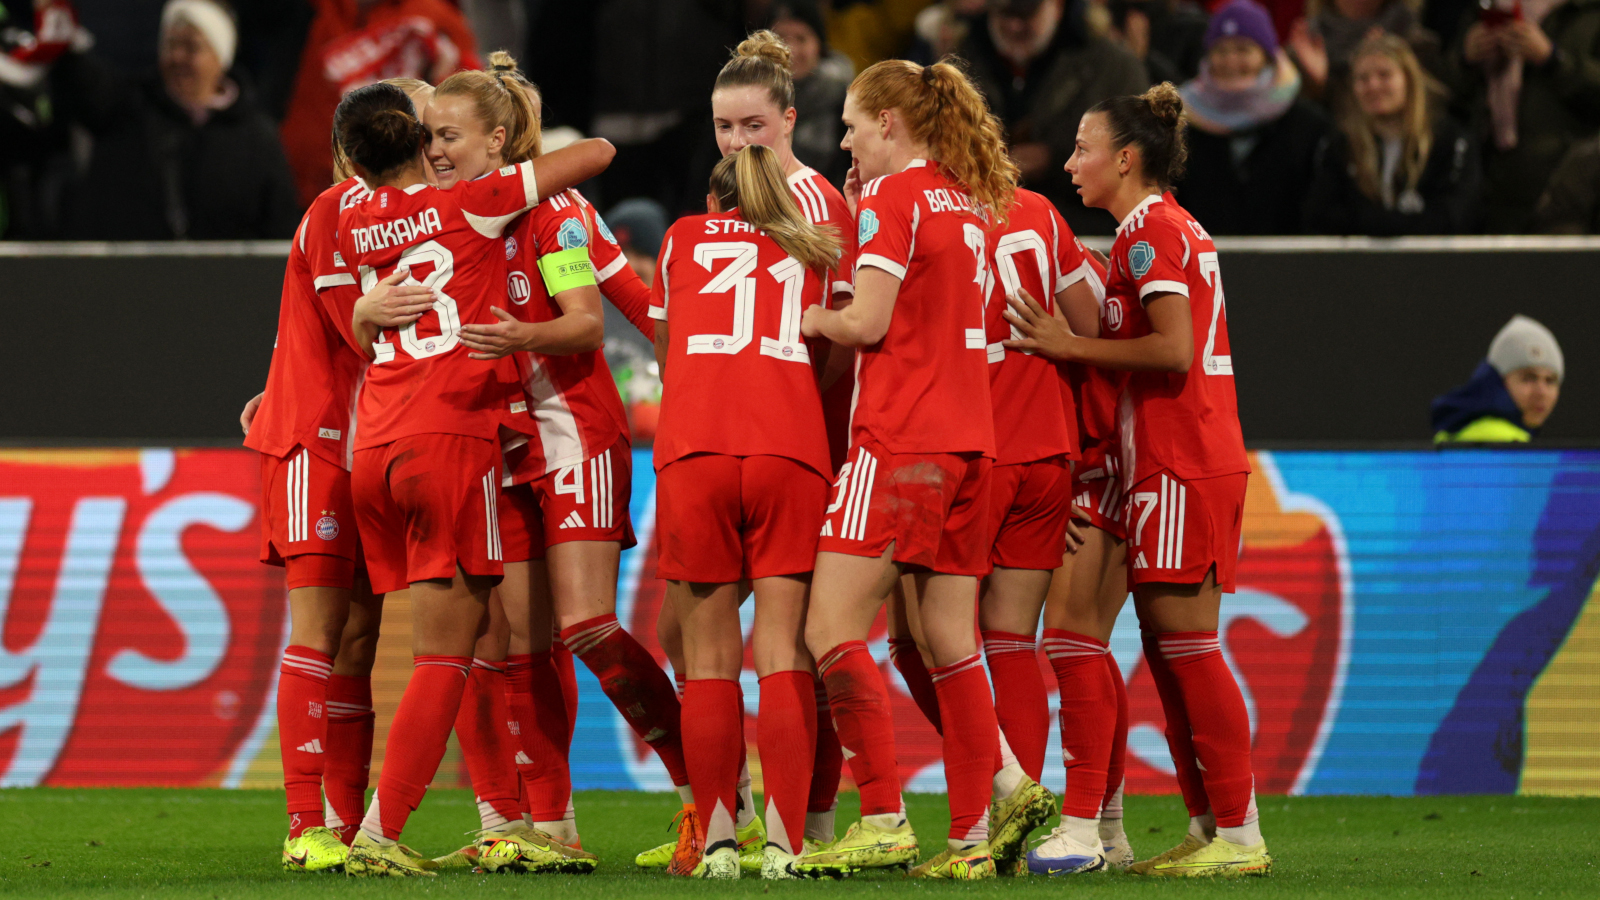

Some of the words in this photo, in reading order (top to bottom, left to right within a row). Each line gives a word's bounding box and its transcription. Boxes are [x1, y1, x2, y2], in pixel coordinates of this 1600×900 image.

[704, 219, 768, 236] STA
[687, 241, 811, 366] 31
[554, 462, 585, 504] 4
[1125, 491, 1158, 548] 7
